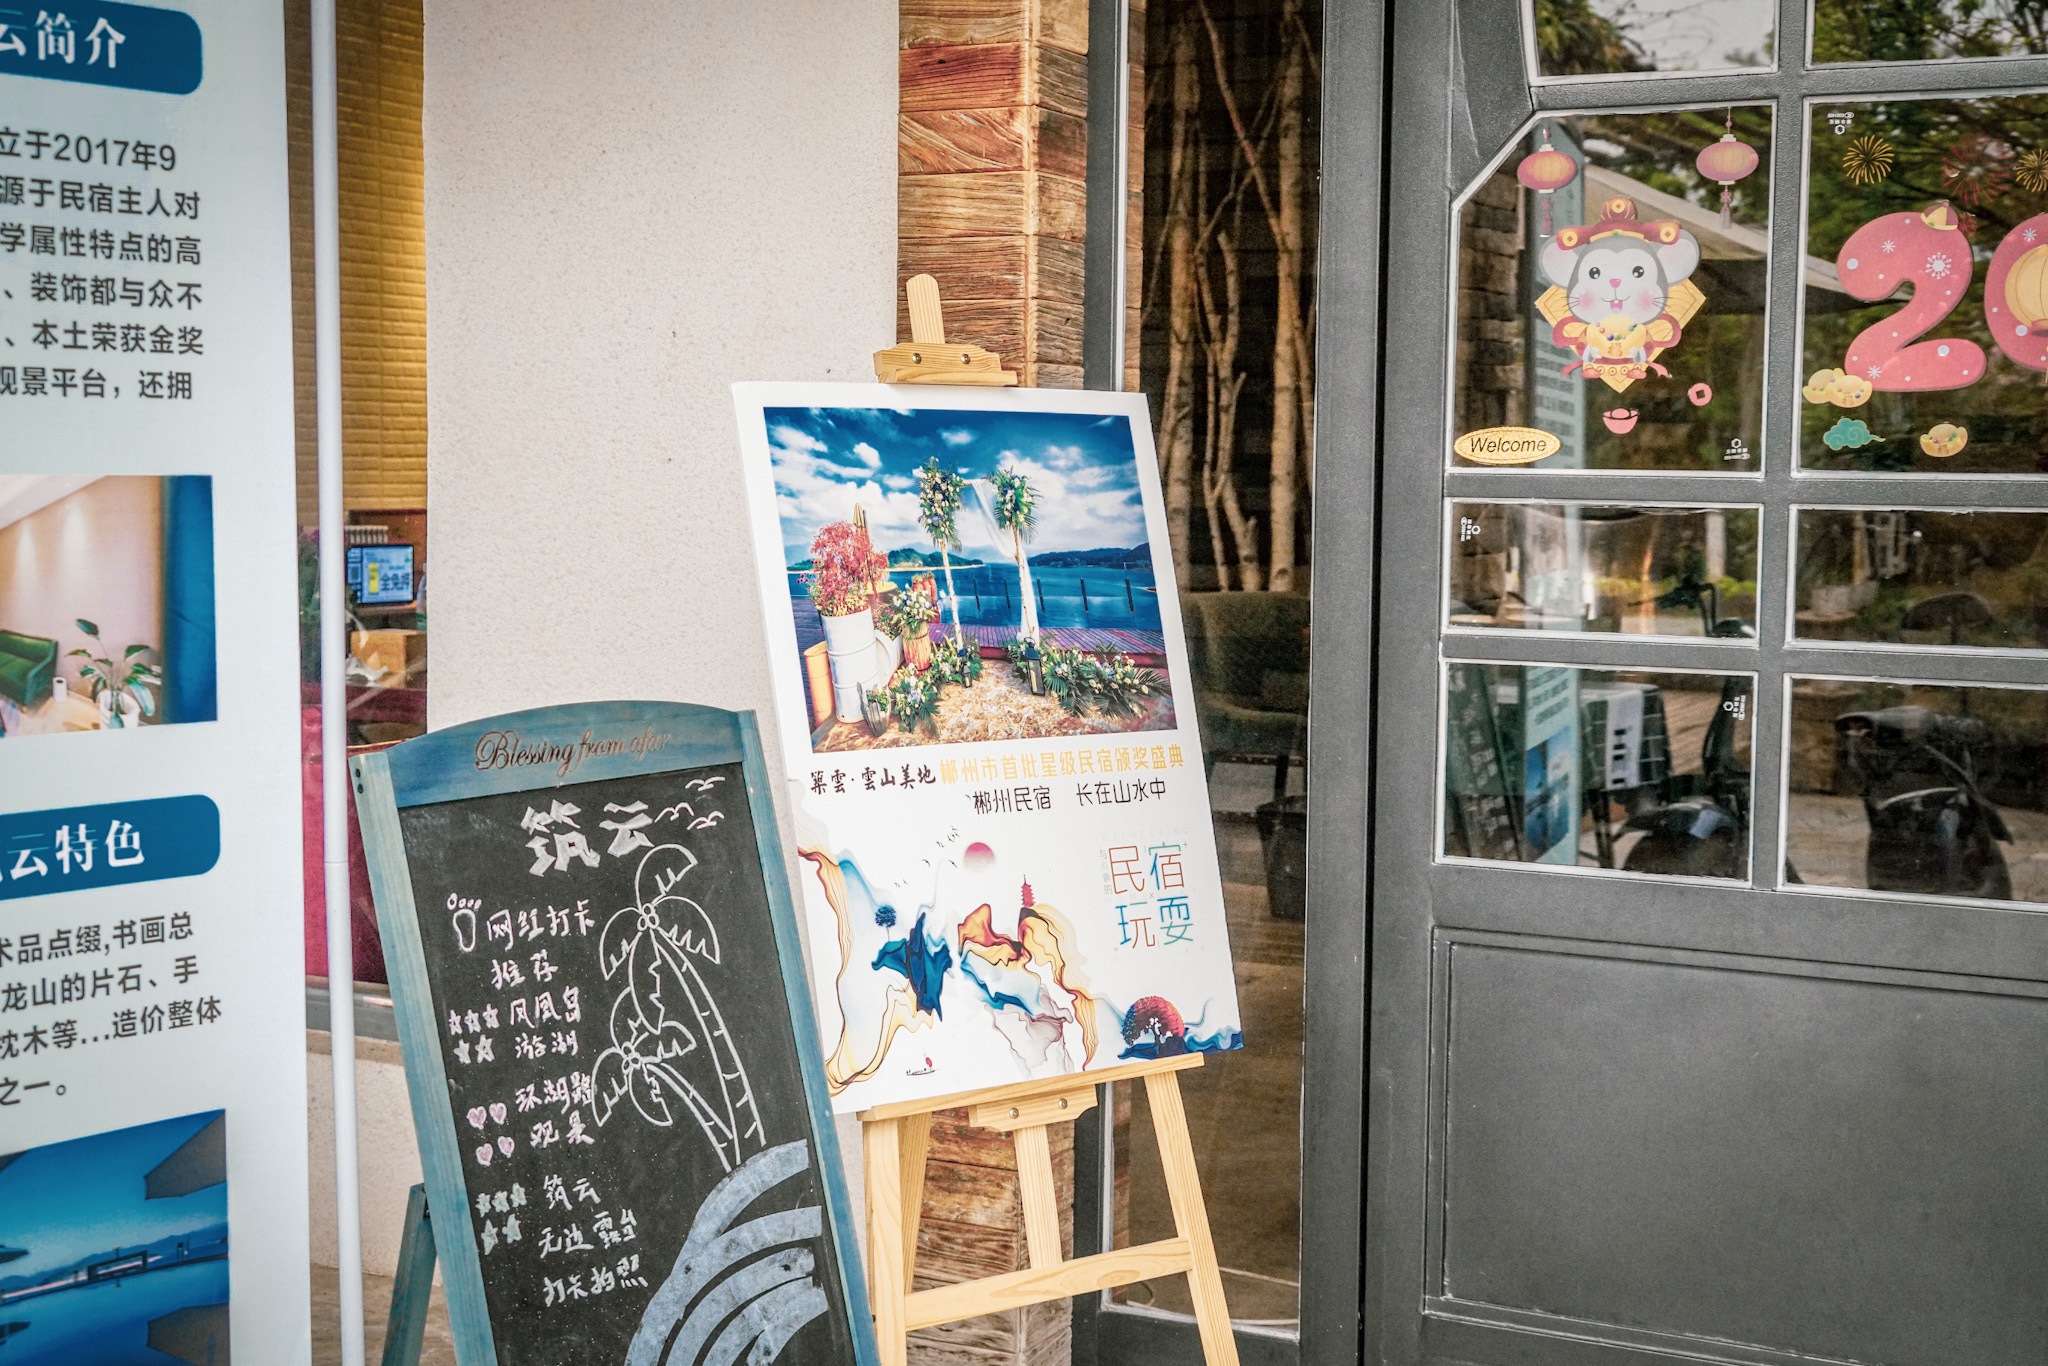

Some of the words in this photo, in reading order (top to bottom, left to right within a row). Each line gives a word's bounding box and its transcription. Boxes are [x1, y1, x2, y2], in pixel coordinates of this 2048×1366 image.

[0, 126, 176, 171] 立于2017年9
[0, 174, 200, 220] 源于民宿主人对
[0, 222, 201, 265] 学属性特点的高
[1469, 437, 1547, 453] Welcome
[474, 729, 576, 778] Blessing
[569, 728, 624, 773] from
[973, 785, 1052, 815] 郴州民宿
[1076, 777, 1167, 807] 长在山水中
[0, 820, 145, 881] 云特色
[520, 799, 655, 877] 筑云
[1108, 842, 1185, 895] 民宿
[486, 899, 595, 951] 网红打卡
[1115, 895, 1194, 949] 玩耍
[1, 955, 199, 1013] 龙山的片石、手
[491, 949, 559, 990] 推荐
[510, 985, 582, 1029] 凤凰岛
[515, 1029, 579, 1060] 游湖
[529, 1109, 596, 1149] 观景
[543, 1174, 601, 1211] 筑云
[538, 1208, 638, 1259] 无边露台
[542, 1253, 649, 1308] 打卡拍照
